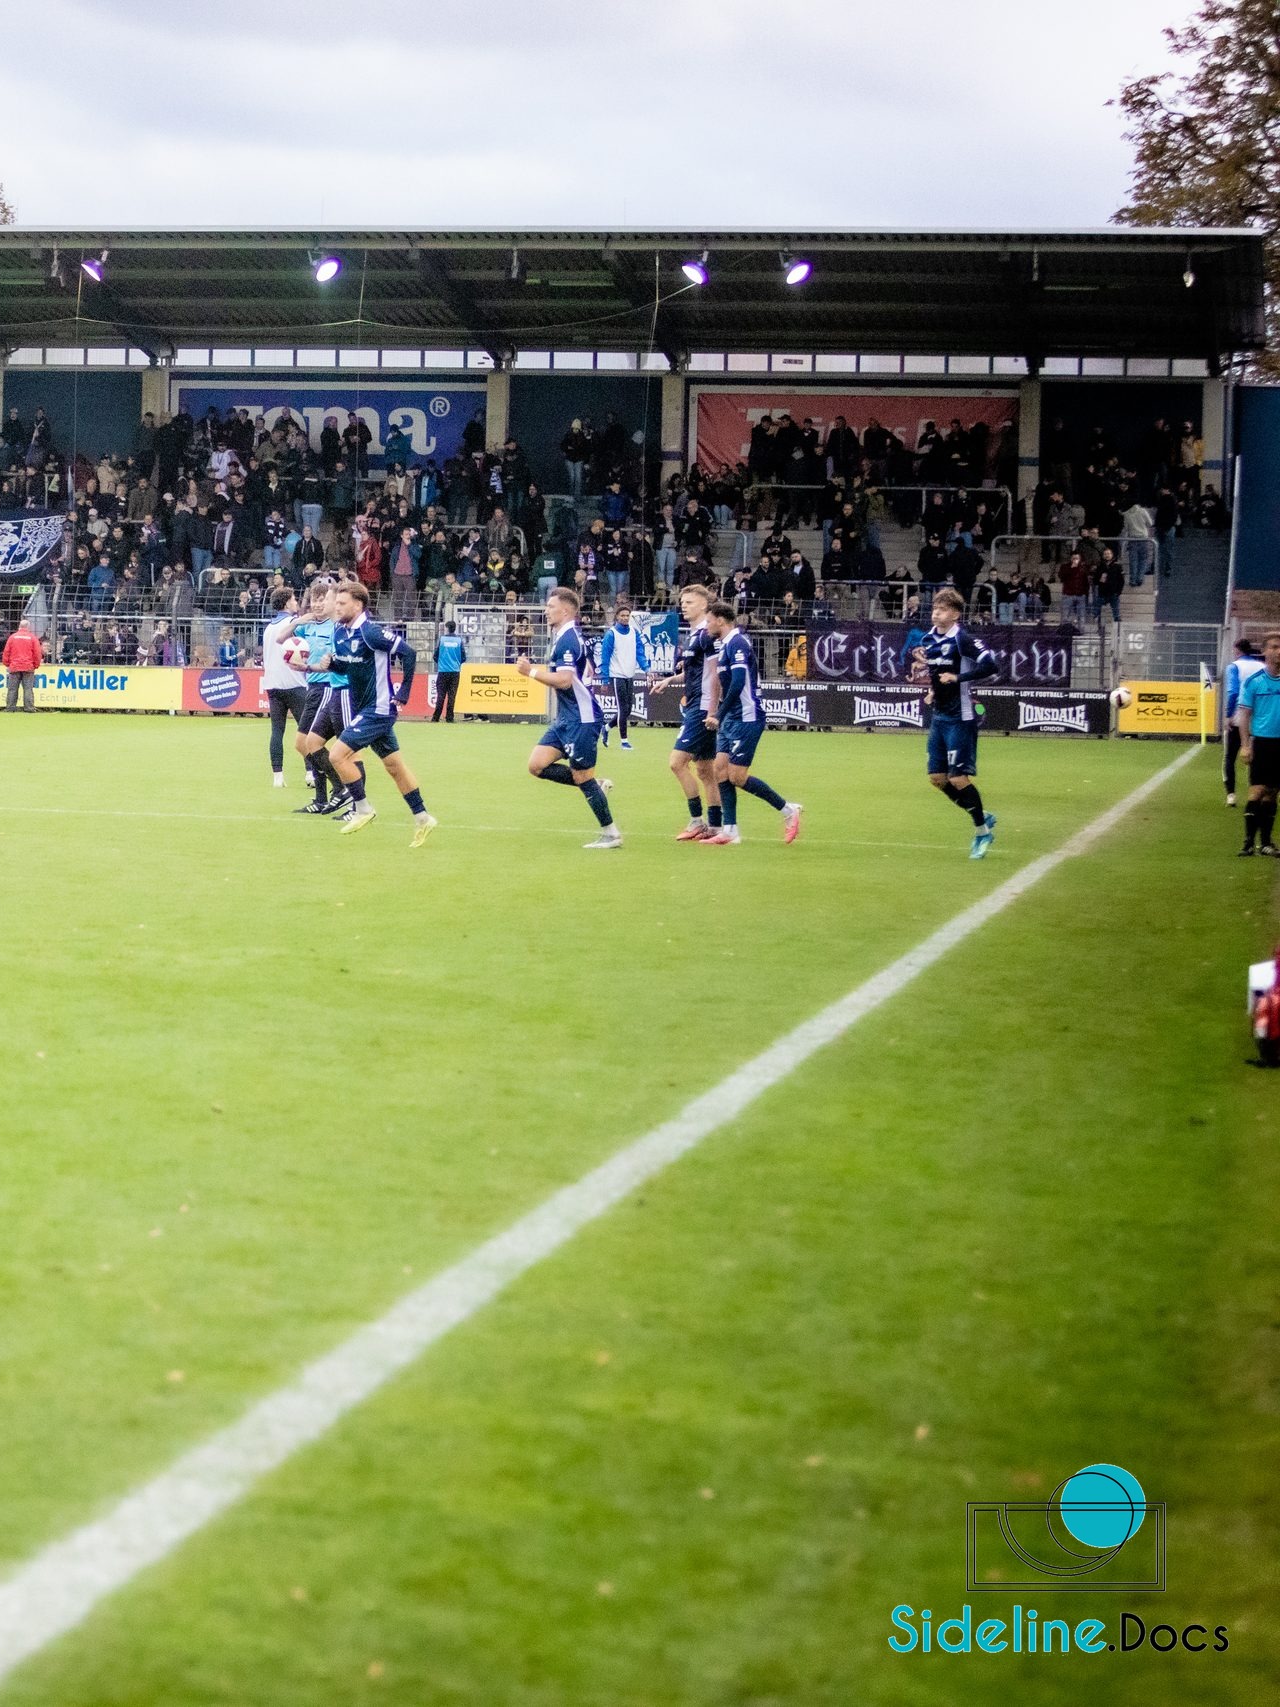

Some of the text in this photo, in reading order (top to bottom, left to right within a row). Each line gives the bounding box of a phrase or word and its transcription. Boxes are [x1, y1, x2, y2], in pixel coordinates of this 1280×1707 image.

[460, 616, 478, 633] 15
[990, 640, 1068, 683] rew
[470, 687, 529, 698] KÖNIG
[852, 685, 880, 693] FOOTBALL
[1020, 690, 1034, 698] LOVE
[1035, 691, 1063, 699] FOOTBALL
[1085, 692, 1107, 700] RACISM
[854, 697, 922, 720] LONSDALE
[1018, 702, 1087, 724] LONSDALE
[1136, 706, 1198, 717] KÖNIG
[731, 739, 741, 753] 7
